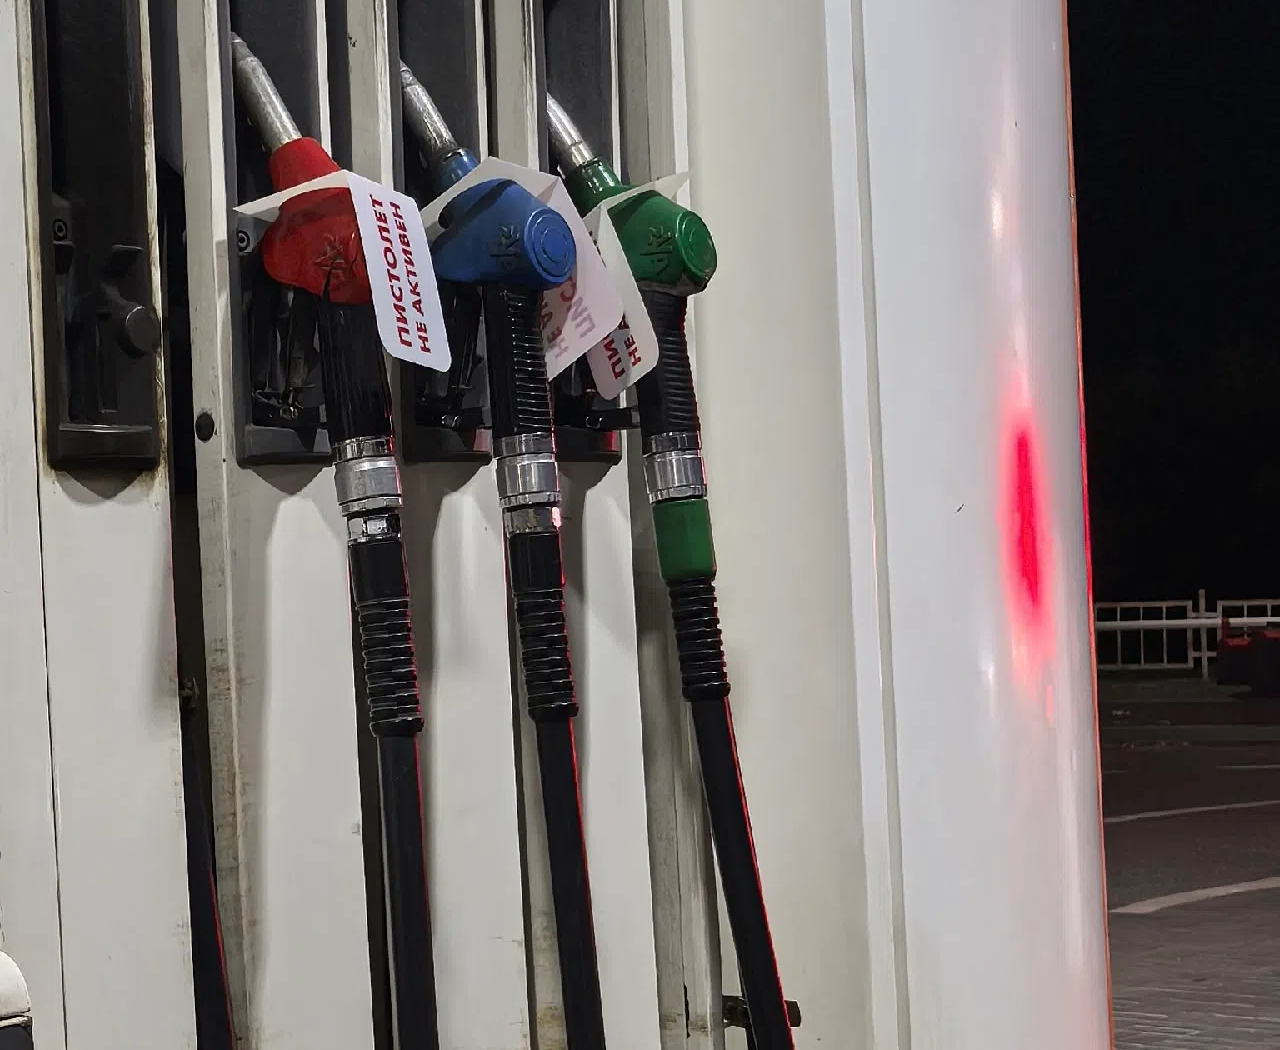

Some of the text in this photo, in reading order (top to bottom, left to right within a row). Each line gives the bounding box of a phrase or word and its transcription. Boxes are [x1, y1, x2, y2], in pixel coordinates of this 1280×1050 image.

[370, 194, 413, 348] ПИСТОЛЕТ
[389, 201, 432, 353] НЕ АКТИВЕН
[624, 334, 641, 366] НЕ
